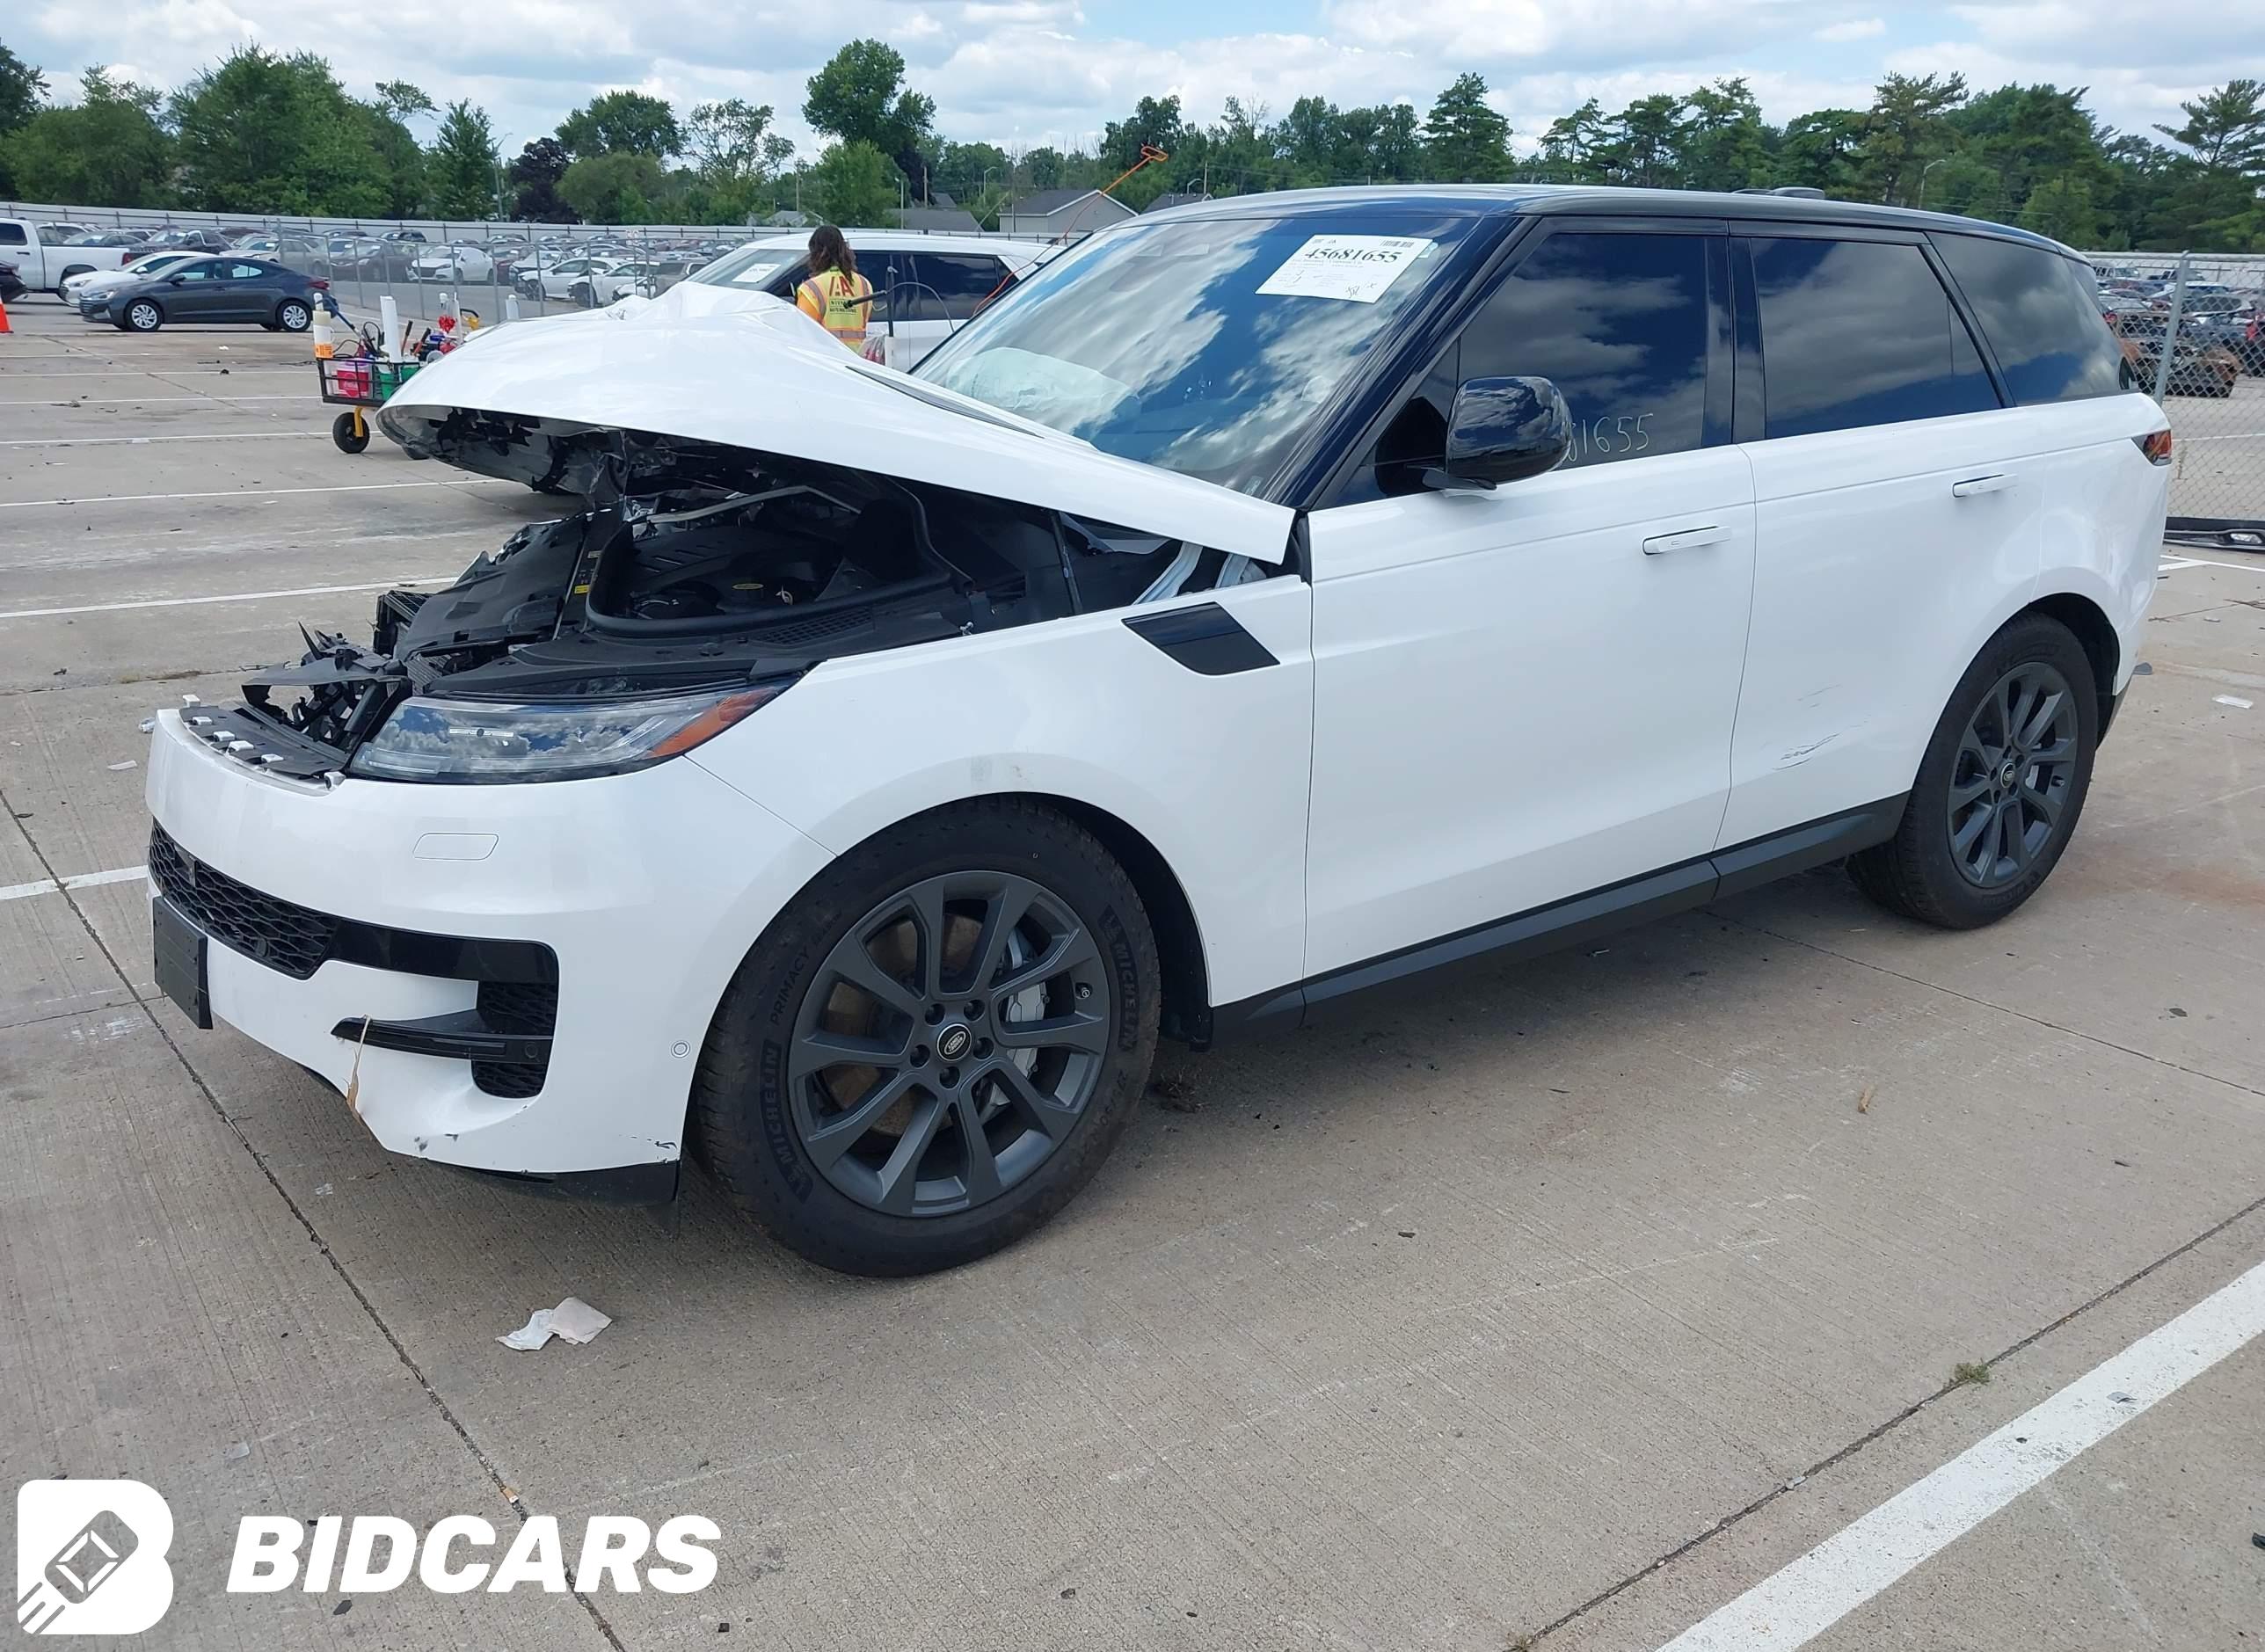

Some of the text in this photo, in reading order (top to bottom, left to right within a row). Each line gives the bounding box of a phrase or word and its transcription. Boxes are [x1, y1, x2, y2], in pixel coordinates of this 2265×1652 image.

[1305, 248, 1403, 264] 45681655
[1569, 412, 1654, 462] 1655
[769, 945, 812, 1025] PRIMACY
[1113, 942, 1138, 1047] MICHELIN
[763, 1045, 795, 1166] MICHELIN
